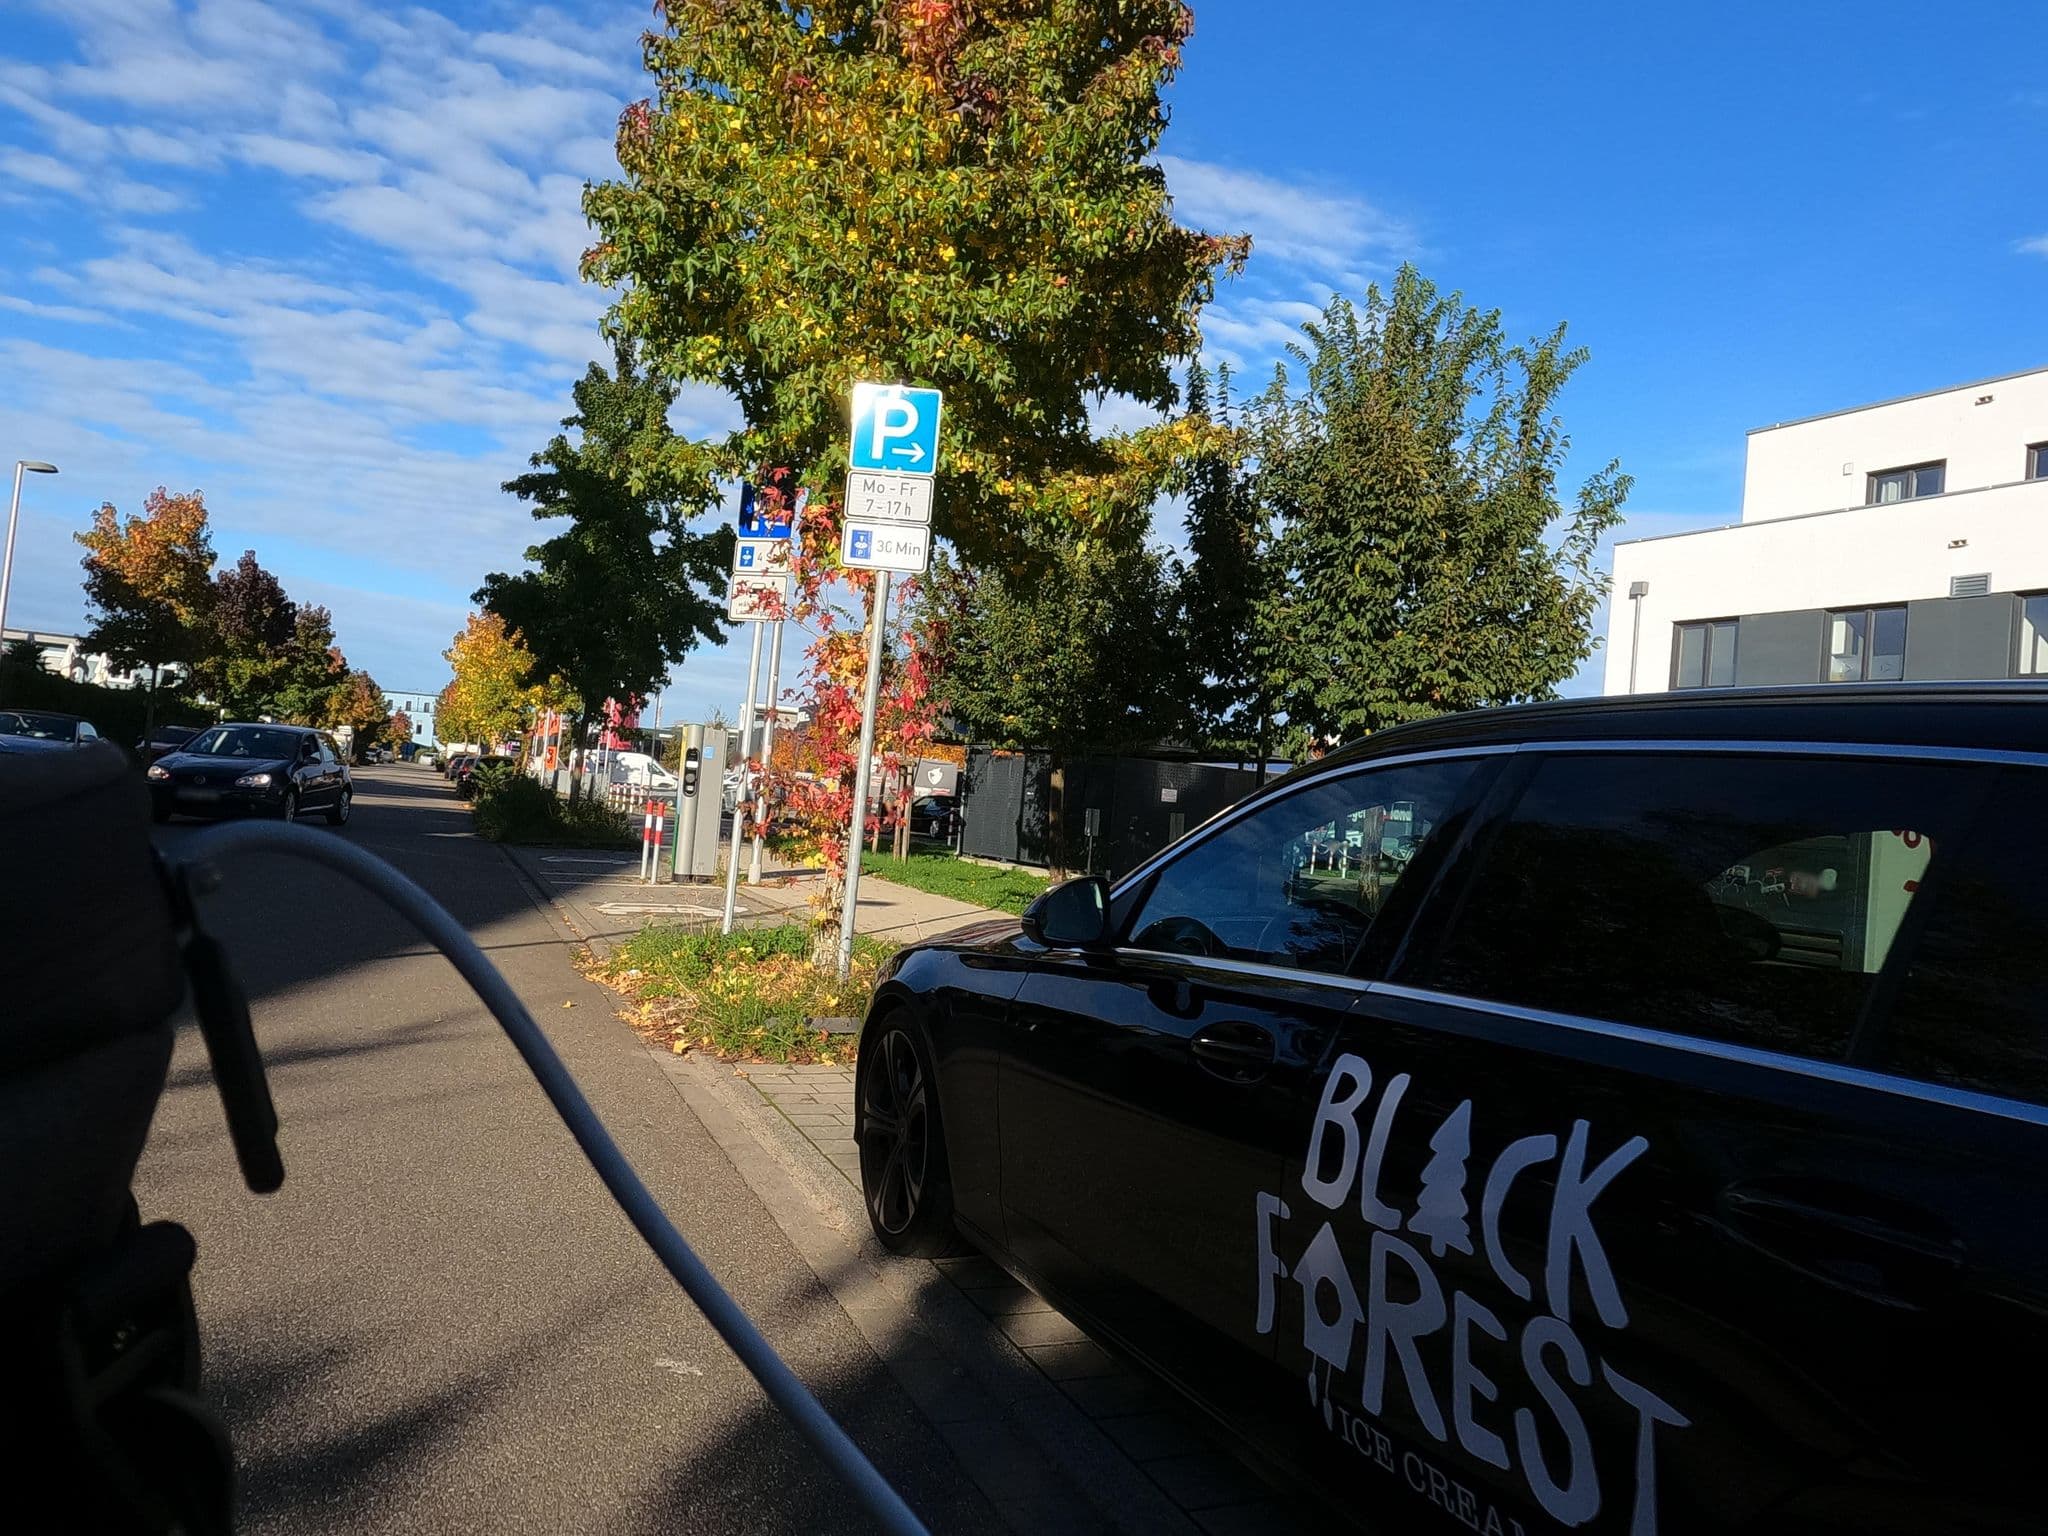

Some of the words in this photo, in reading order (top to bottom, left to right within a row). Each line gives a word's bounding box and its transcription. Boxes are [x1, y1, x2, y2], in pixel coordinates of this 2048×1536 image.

[871, 397, 919, 459] P
[862, 479, 885, 494] Mo
[900, 482, 917, 496] Fr
[876, 540, 893, 553] 30
[895, 541, 921, 556] Min
[1256, 1191, 1692, 1536] FOREST
[1337, 1405, 1395, 1474] ICE
